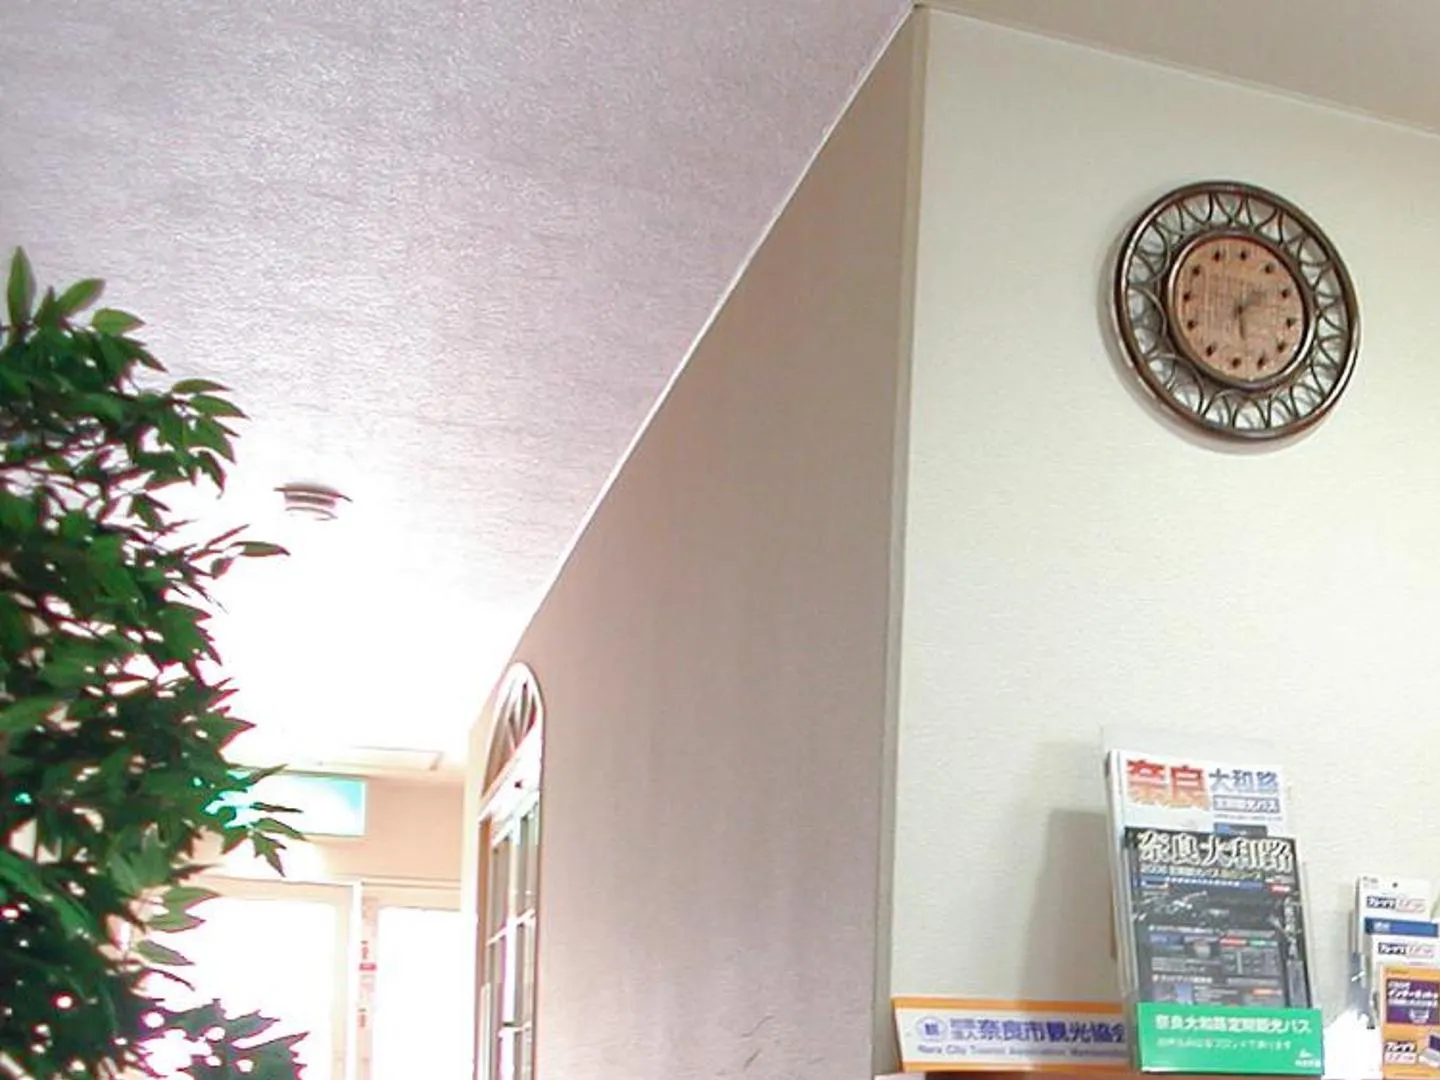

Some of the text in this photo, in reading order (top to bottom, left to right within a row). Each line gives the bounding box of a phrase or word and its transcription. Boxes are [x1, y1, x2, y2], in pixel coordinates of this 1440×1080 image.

[1126, 759, 1211, 811] 奈良
[1137, 830, 1294, 873] 奈良大和路
